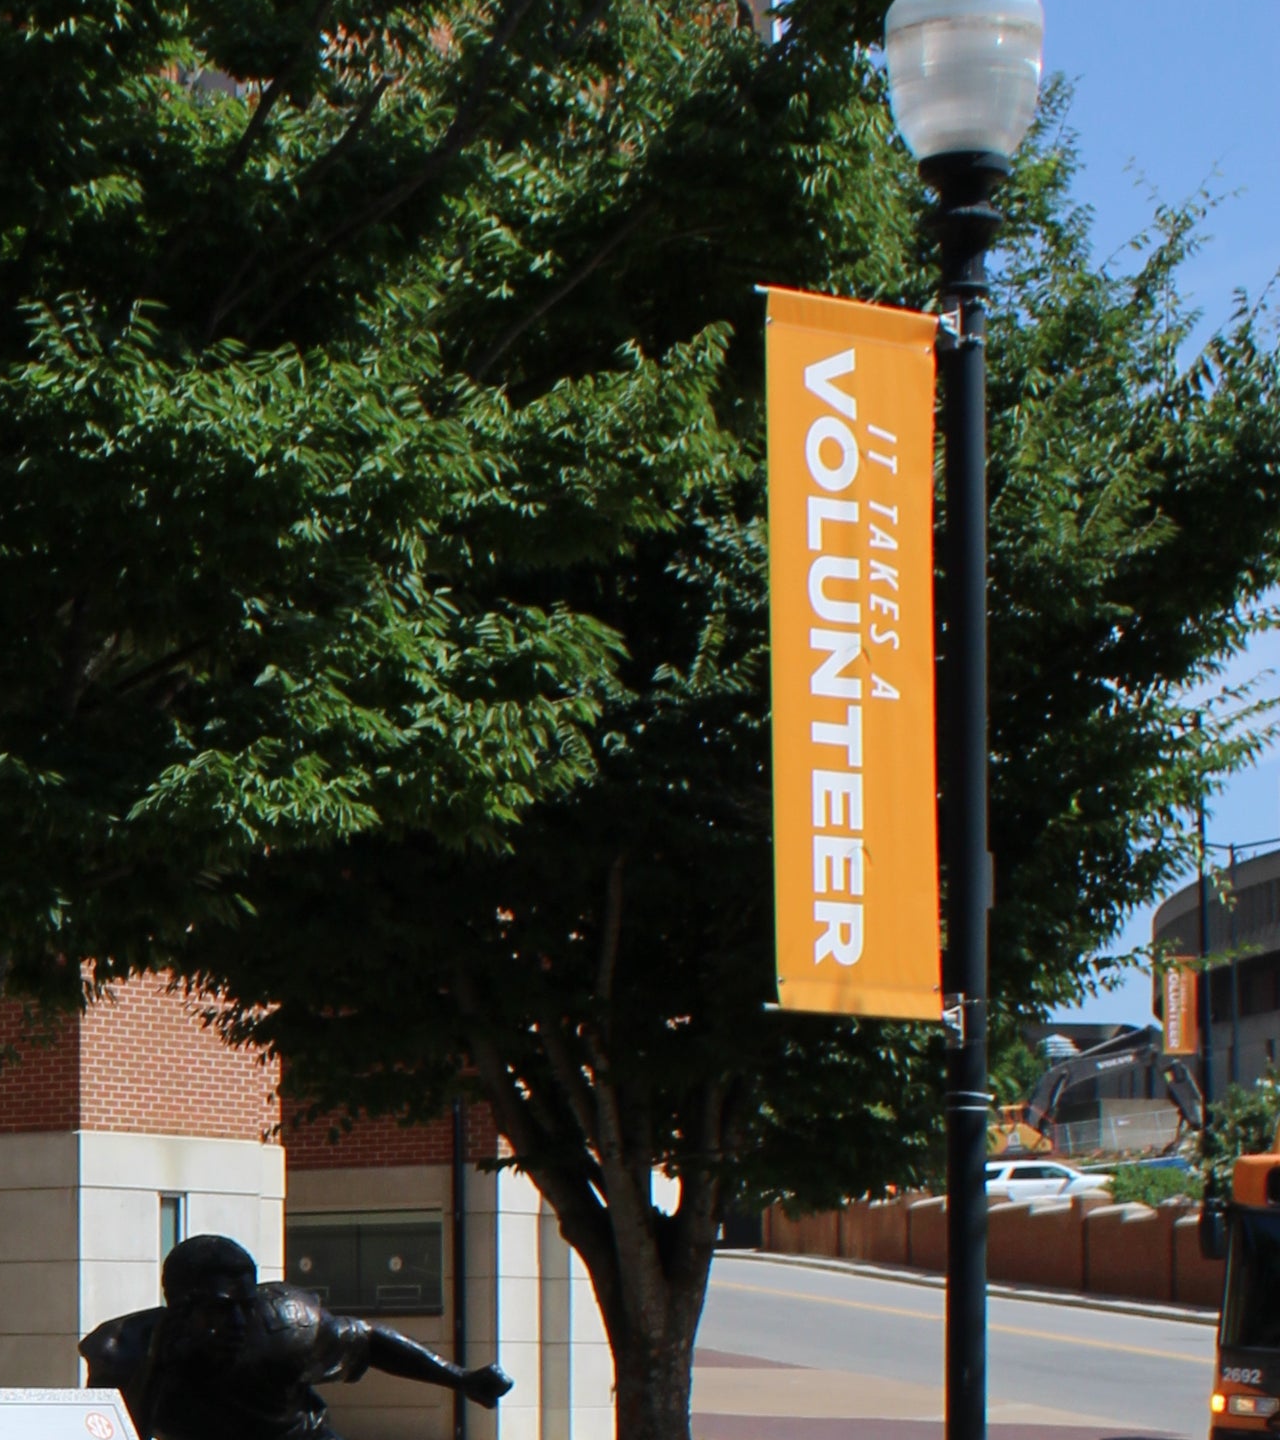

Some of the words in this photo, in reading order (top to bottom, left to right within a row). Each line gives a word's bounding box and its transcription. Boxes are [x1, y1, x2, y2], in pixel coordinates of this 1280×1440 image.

[867, 423, 898, 477] IT
[867, 499, 900, 651] TAKES
[803, 347, 866, 967] VOLUNTEER
[871, 673, 901, 702] A
[1222, 1366, 1262, 1384] 2692
